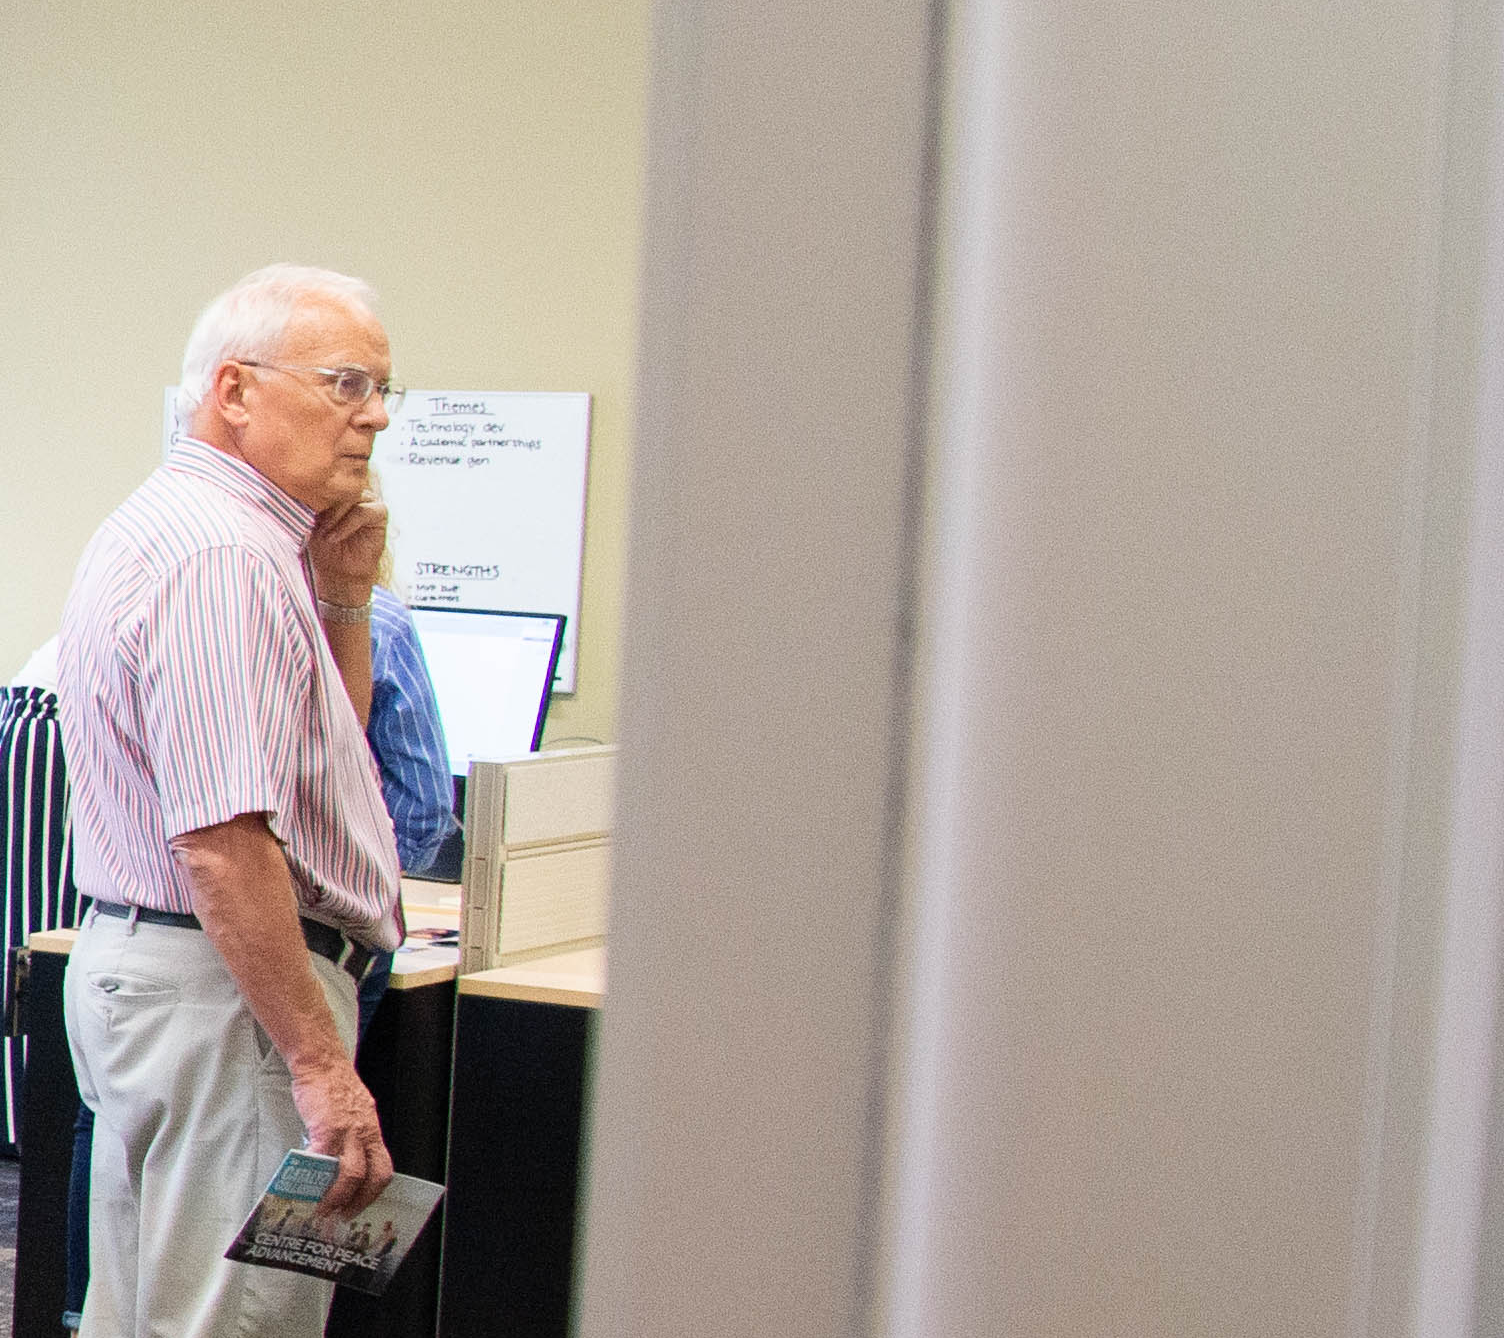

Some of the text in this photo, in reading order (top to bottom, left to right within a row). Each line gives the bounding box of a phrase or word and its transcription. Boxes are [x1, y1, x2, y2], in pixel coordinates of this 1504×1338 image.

[428, 397, 487, 414] Themes
[408, 419, 505, 438] Technology dev
[408, 453, 462, 465] Revenue
[416, 561, 500, 578] STRENGTHS
[245, 1244, 346, 1274] ADVANCEMENT
[255, 1232, 382, 1271] CENTRE FOR PEACE
